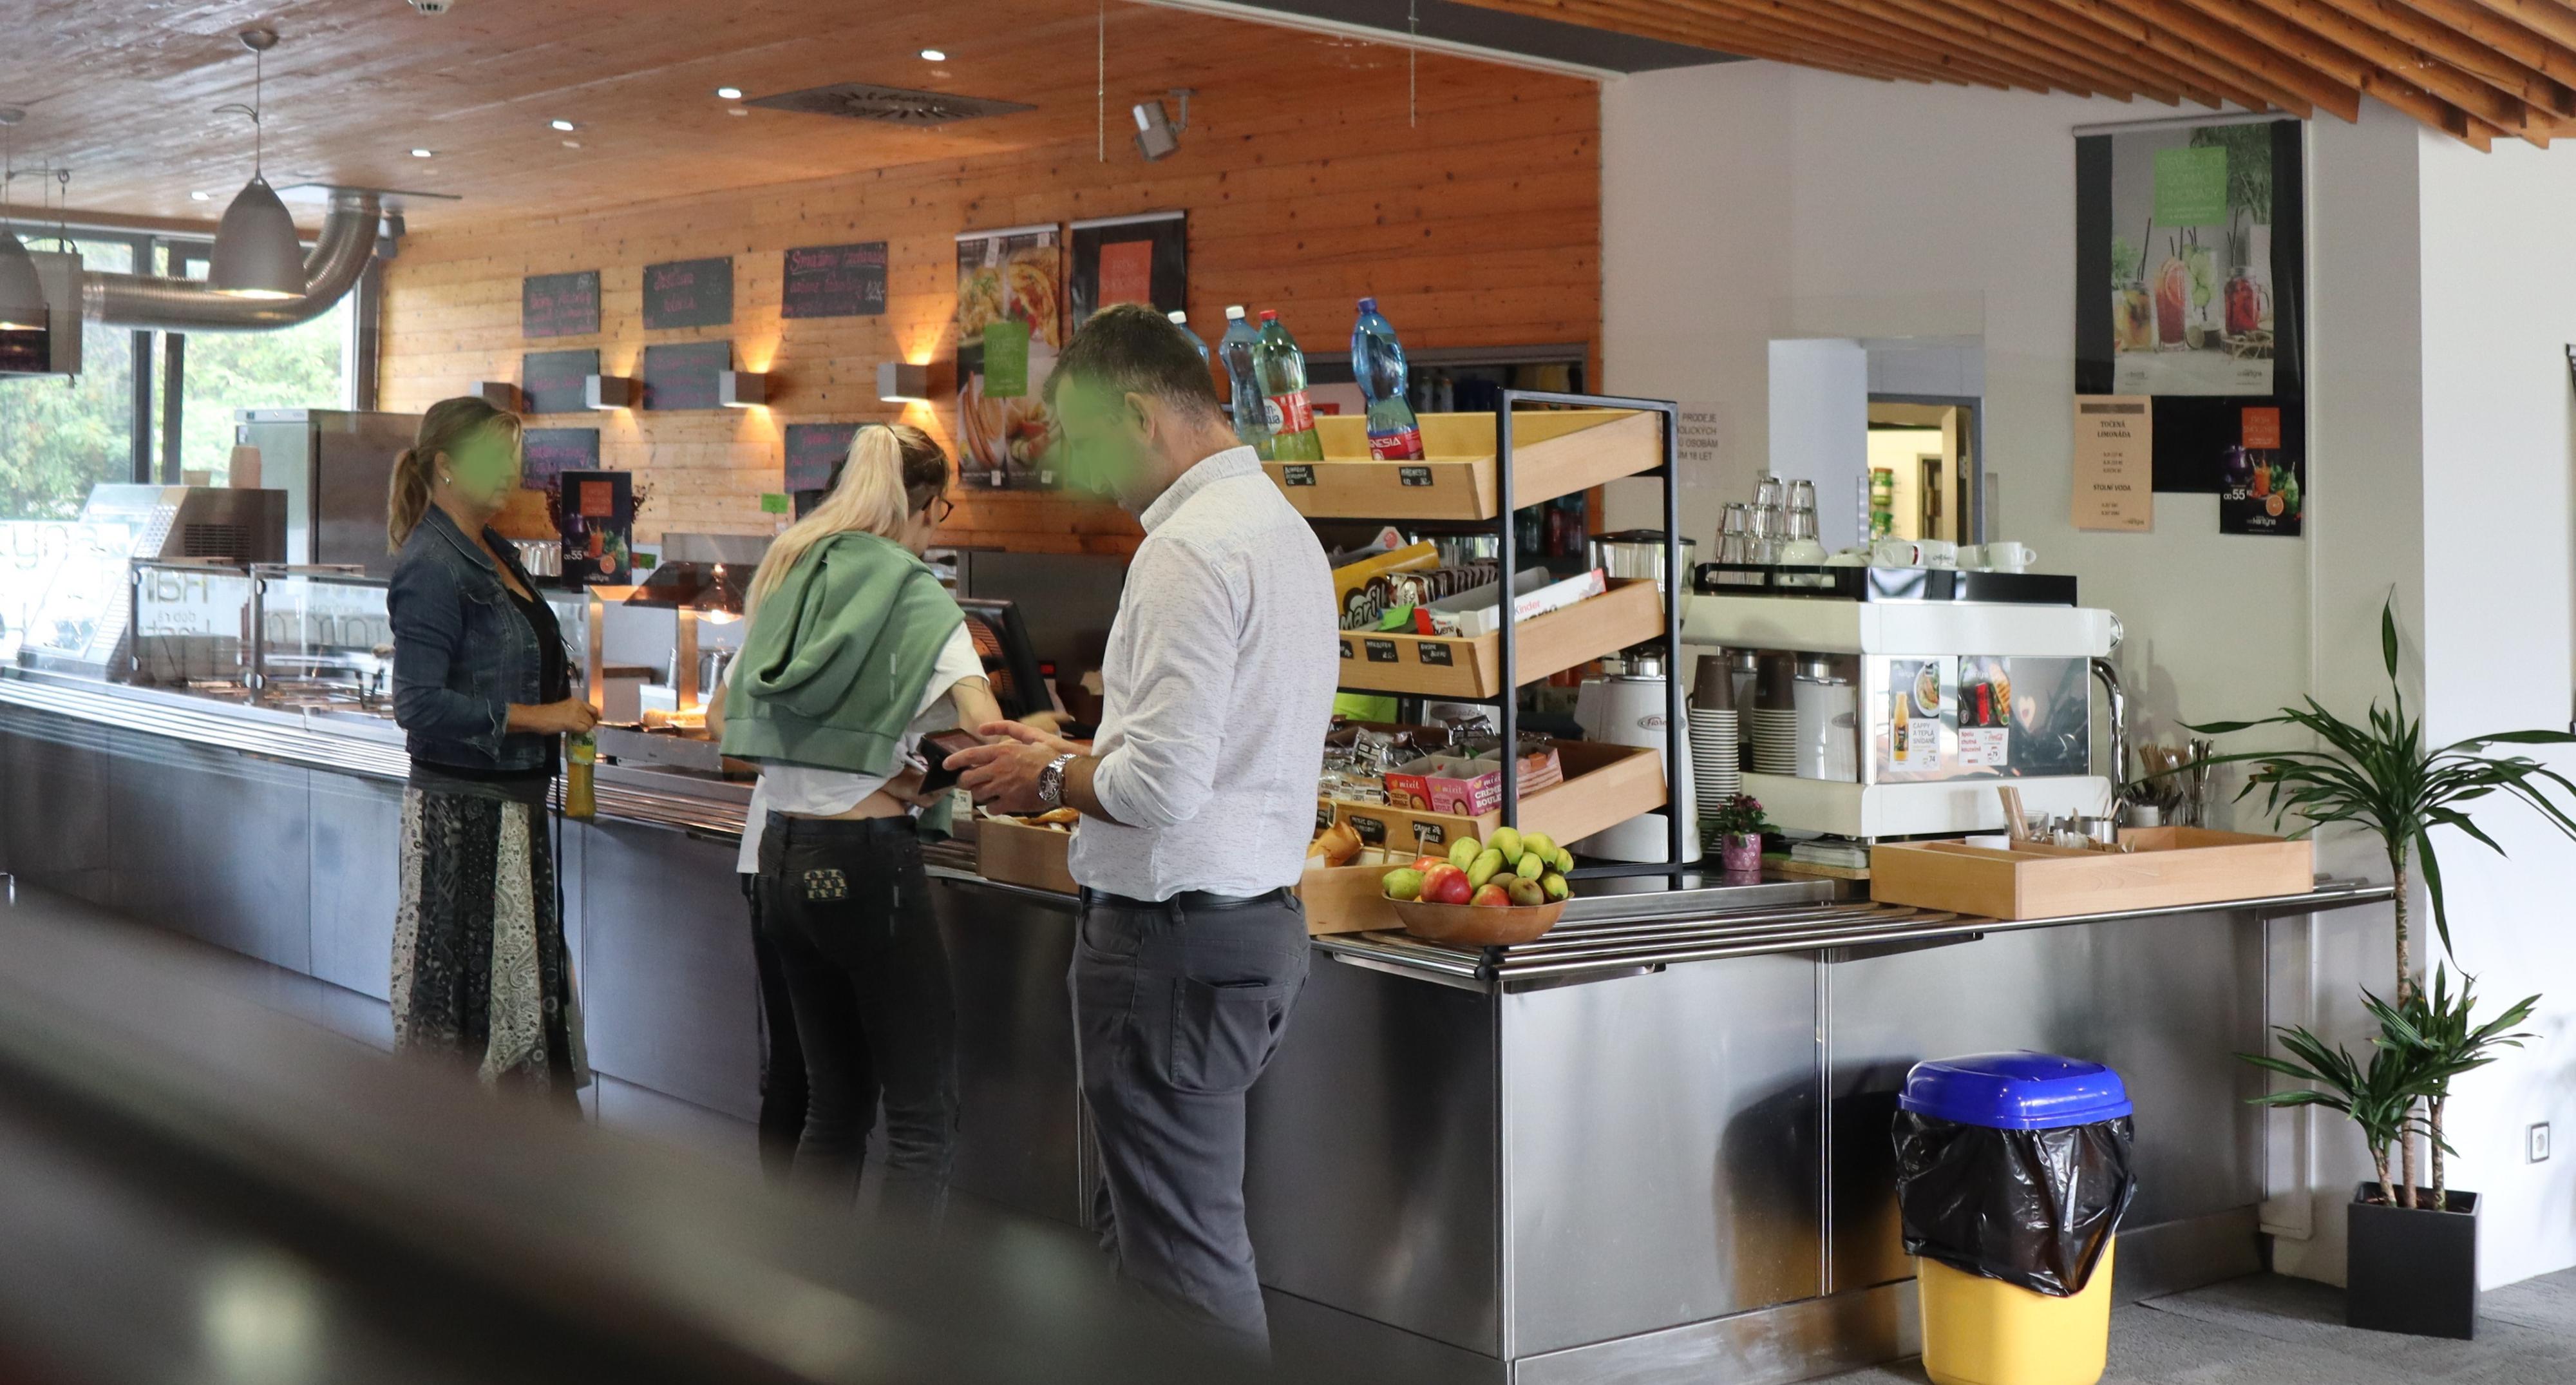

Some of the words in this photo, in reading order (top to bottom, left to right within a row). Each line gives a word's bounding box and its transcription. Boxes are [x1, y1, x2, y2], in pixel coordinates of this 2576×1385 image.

[1683, 413, 1717, 423] PRODEJE
[1700, 452, 1712, 461] LET
[2232, 488, 2245, 500] 55
[1399, 779, 1419, 789] mixit
[1442, 785, 1463, 794] mixit
